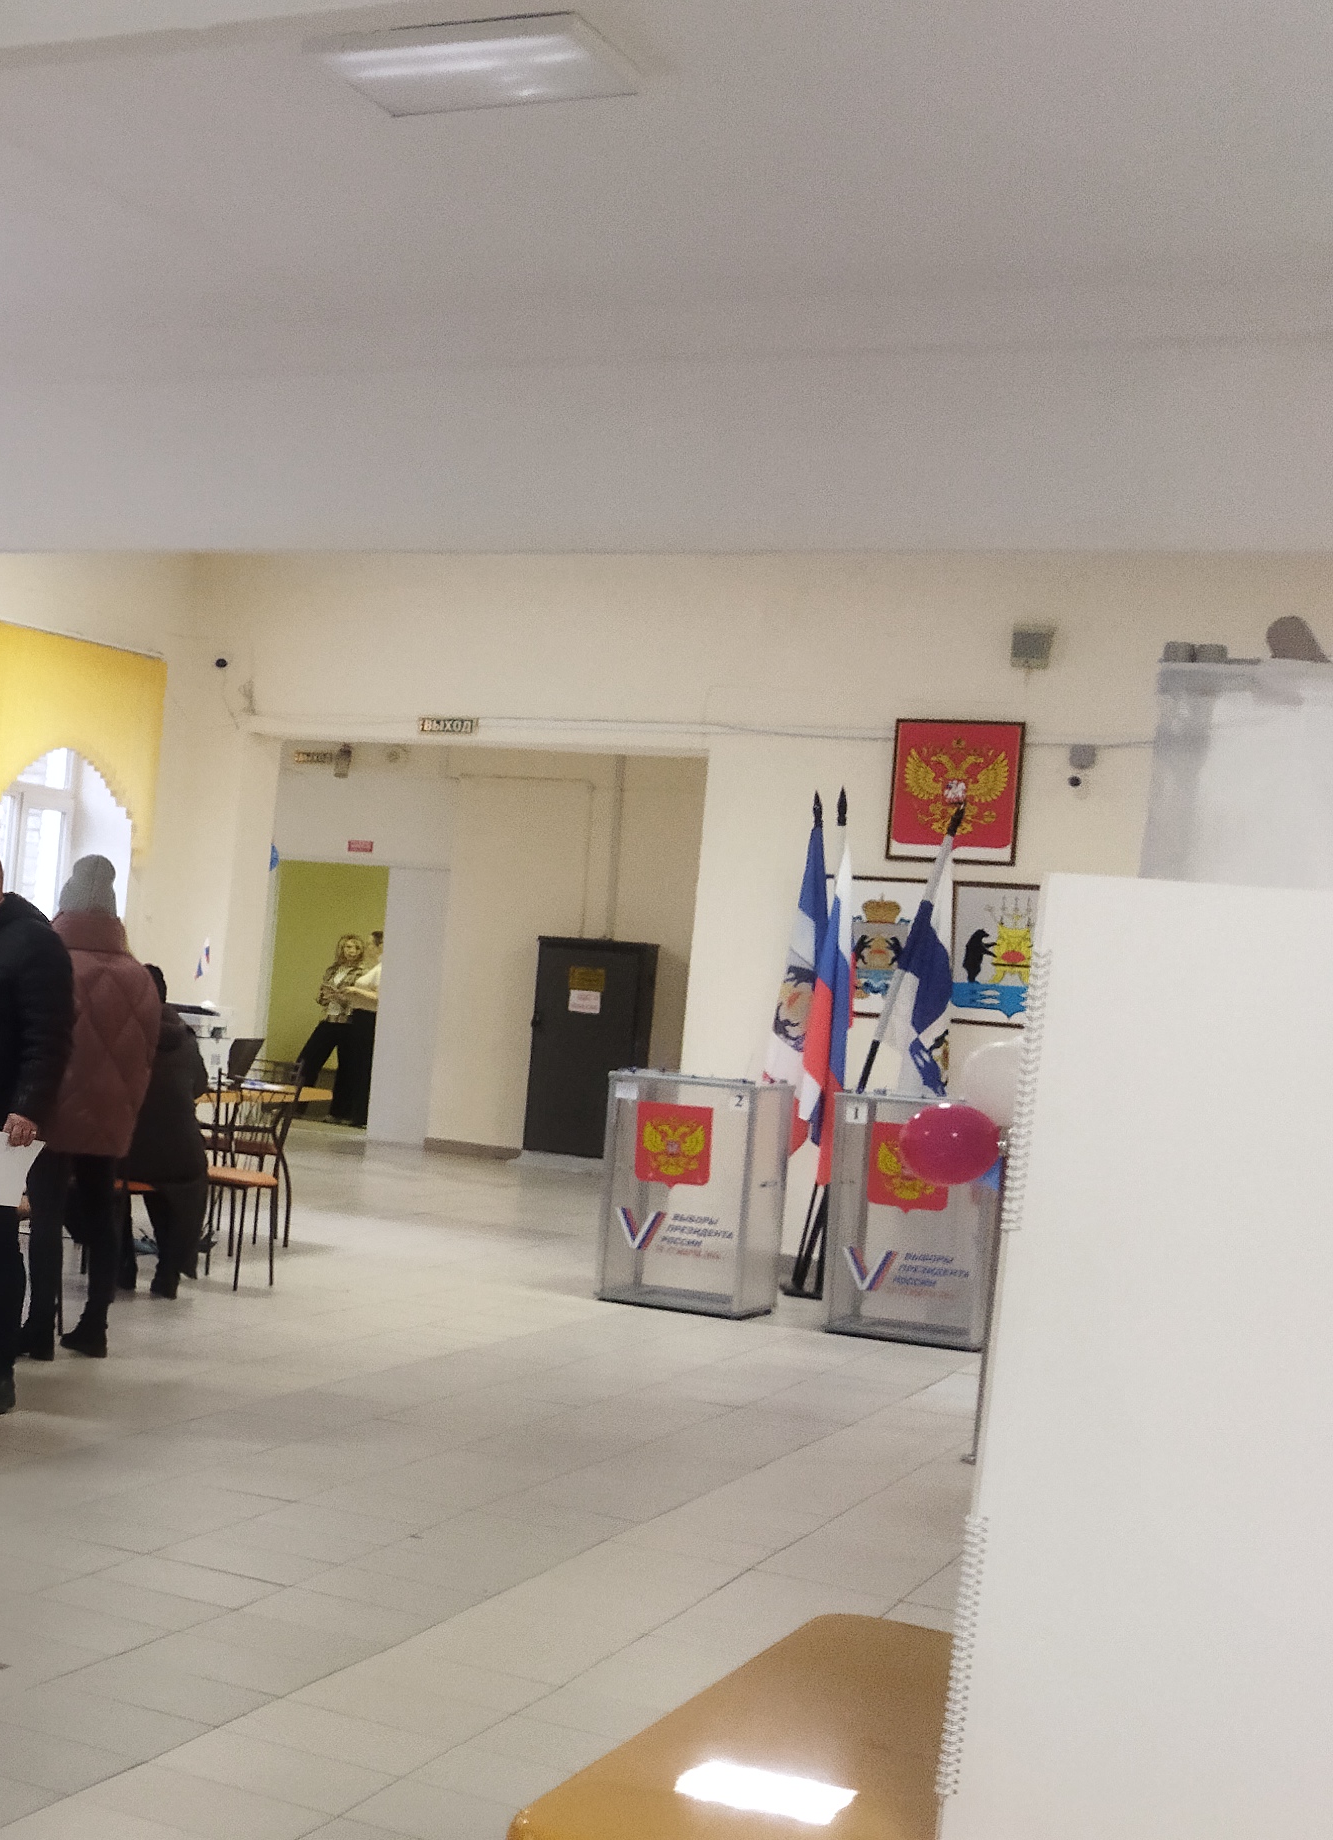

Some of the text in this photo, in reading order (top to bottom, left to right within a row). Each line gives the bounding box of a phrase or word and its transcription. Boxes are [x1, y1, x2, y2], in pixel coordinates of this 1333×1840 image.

[423, 719, 473, 734] ВЫХОД
[734, 1094, 745, 1107] 2
[671, 1213, 719, 1225] ВЫБОРЫ
[666, 1224, 734, 1239] ПРЕЗИДЕНТА
